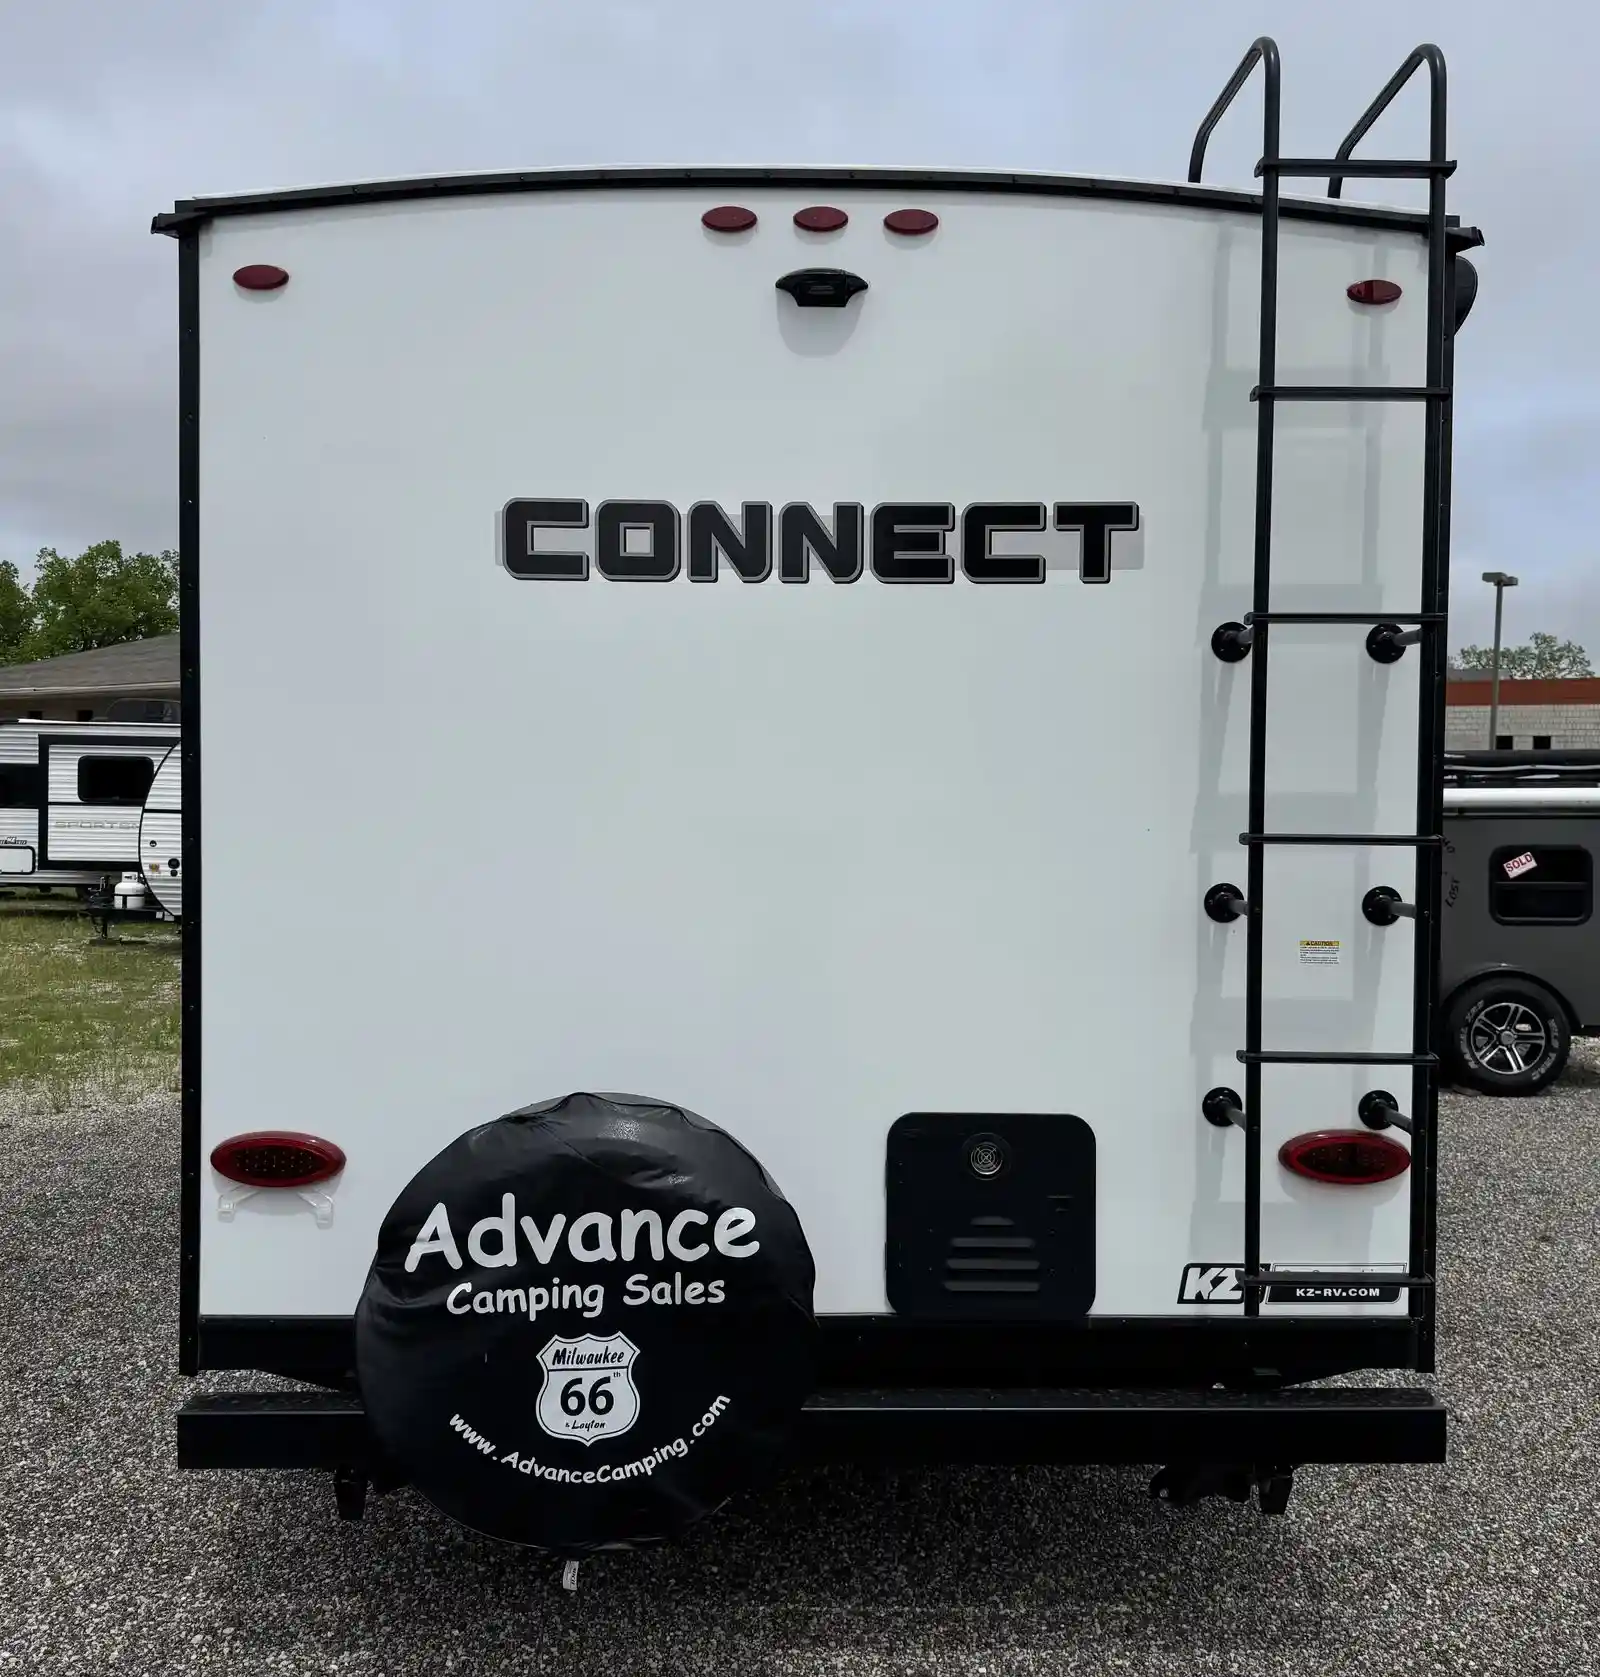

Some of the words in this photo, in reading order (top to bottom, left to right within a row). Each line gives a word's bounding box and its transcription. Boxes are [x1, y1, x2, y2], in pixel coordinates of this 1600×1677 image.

[501, 498, 1140, 584] CONNECT
[1505, 853, 1533, 873] SOLD
[404, 1193, 760, 1273] Advance
[446, 1277, 605, 1322] Camping
[622, 1271, 726, 1306] Sales
[1183, 1267, 1244, 1300] KZ
[1296, 1288, 1380, 1297] KZ-RV.COM
[552, 1346, 625, 1366] Milwaukee
[450, 1394, 731, 1484] www.AdvanceCamping.com
